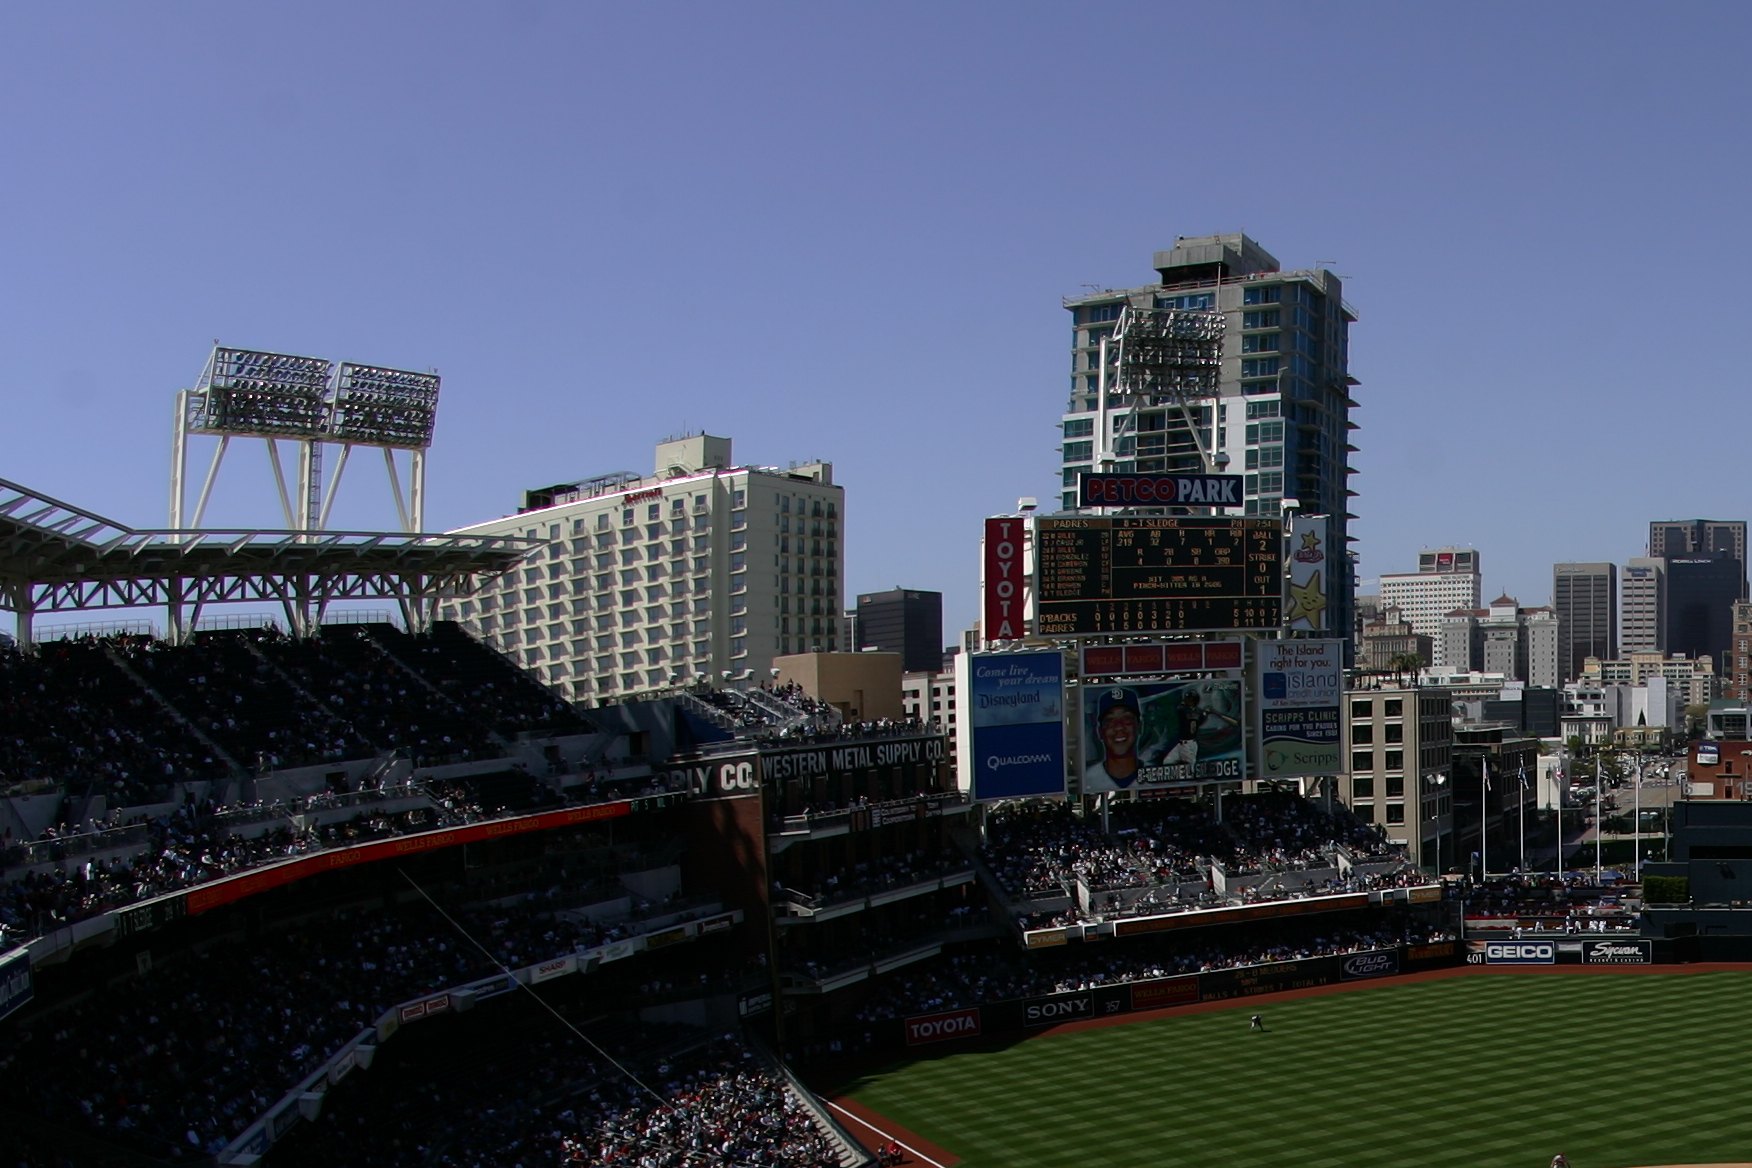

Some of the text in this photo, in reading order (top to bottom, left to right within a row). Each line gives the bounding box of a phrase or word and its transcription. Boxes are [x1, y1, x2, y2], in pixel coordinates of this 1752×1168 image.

[1087, 478, 1237, 503] PETCO PARK
[1053, 520, 1088, 528] PADRES
[1146, 519, 1178, 527] SLEDGE
[1117, 530, 1135, 538] AVG
[1253, 531, 1273, 540] BALL
[1260, 541, 1266, 550] 2
[1249, 553, 1277, 562] STRIKE
[1259, 564, 1266, 573] 0
[997, 522, 1014, 637] TOYOTA
[1254, 576, 1271, 584] OUT
[1039, 613, 1077, 623] D'BACKS
[1095, 612, 1100, 621] 0
[1109, 612, 1115, 620] 0
[1124, 612, 1129, 620] 0
[1138, 611, 1143, 619] 0
[1152, 611, 1157, 619] 3
[1179, 610, 1184, 618] 0
[1245, 609, 1254, 617] 10
[1039, 624, 1074, 633] PADRES
[1138, 621, 1143, 630] 0
[1152, 621, 1157, 629] 0
[1165, 620, 1171, 629] 0
[1179, 620, 1184, 628] 2
[1276, 644, 1324, 656] The Island
[1087, 655, 1122, 666] WELLS
[1167, 653, 1201, 664] WELLS
[1270, 656, 1332, 671] right for you.
[976, 665, 1029, 679] Come live
[997, 673, 1059, 690] your dream
[1288, 671, 1338, 689] island
[979, 690, 1041, 709] Disneyland
[1265, 711, 1338, 723] SCRIPPS CLINIC
[761, 740, 945, 779] WESTERN METAL SUPPLY CO.
[987, 753, 1052, 772] QUALCOMM
[1294, 752, 1338, 767] Scripps
[720, 761, 759, 791] CO.
[1683, 782, 1692, 796] 6
[567, 806, 616, 822] WELLS FARGO
[486, 818, 540, 835] WELLS FARGO
[395, 833, 455, 853] WELLS FARGO
[330, 850, 361, 865] FARGO
[1029, 934, 1066, 946] CYMER
[1487, 944, 1552, 959] GEICO
[1589, 941, 1643, 957] Sycuan
[1355, 954, 1387, 966] BUD
[1466, 953, 1482, 964] 401
[538, 959, 566, 974] SHARP
[1351, 961, 1394, 974] LIGHT
[1135, 982, 1196, 999] WELLS FARGO
[1026, 998, 1089, 1020] SONY
[909, 1015, 977, 1038] TOYOTA
